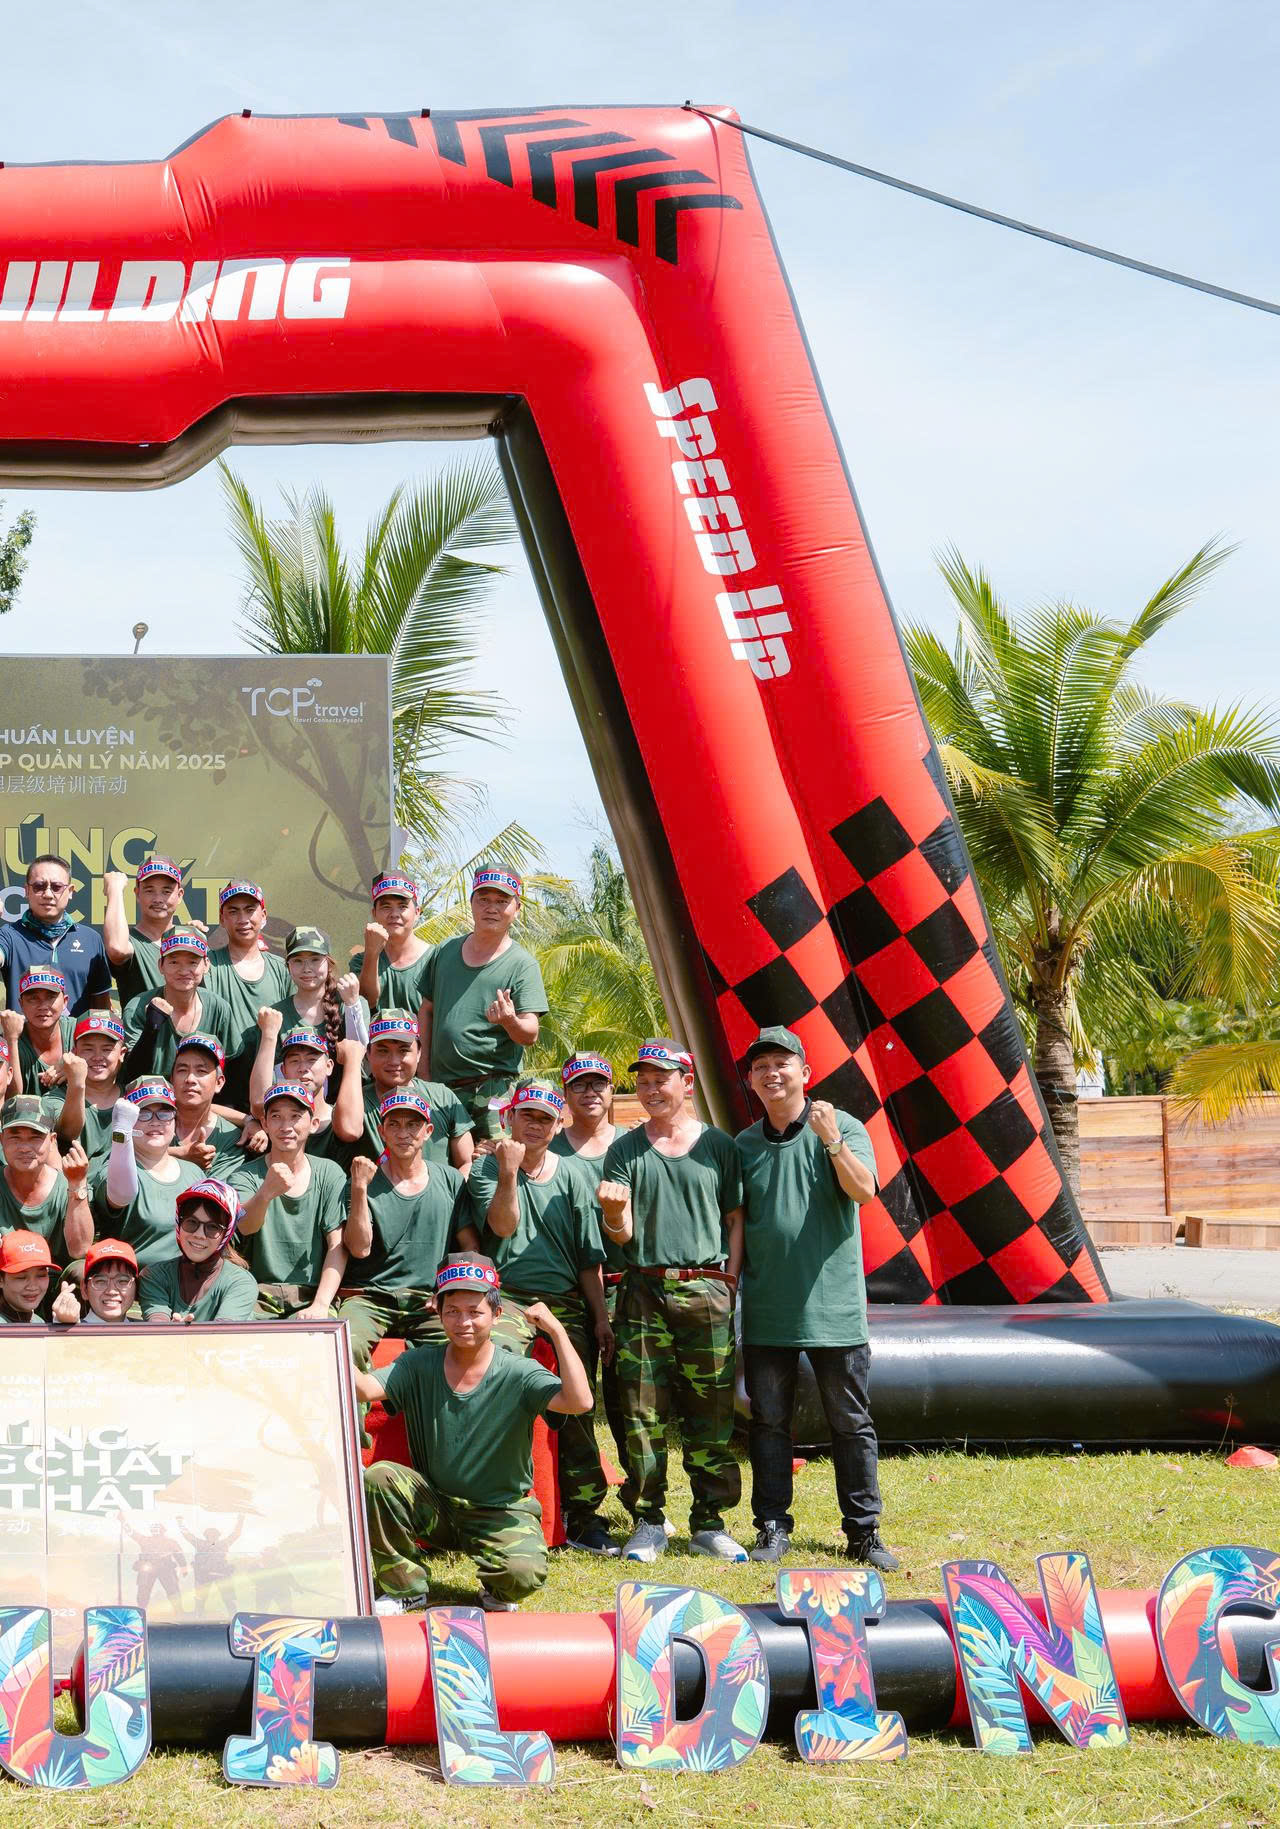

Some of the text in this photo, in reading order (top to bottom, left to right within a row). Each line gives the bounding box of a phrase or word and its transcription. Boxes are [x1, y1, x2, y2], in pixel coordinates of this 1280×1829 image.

[314, 701, 364, 717] travel
[64, 725, 135, 749] LUYỆN
[19, 749, 83, 772] QUẢN
[89, 750, 114, 770] LÝ
[120, 751, 170, 770] NĂM
[176, 754, 227, 770] 2025
[143, 864, 179, 878] TRIBECO
[378, 880, 414, 892] TRIBECO
[479, 874, 517, 888] TRIBECO
[168, 936, 206, 950] TRIBECO
[371, 1021, 411, 1031] TRIBECO
[570, 1060, 611, 1073] TRIBECO
[127, 1086, 168, 1102] TRIBECO
[386, 1096, 426, 1110] TRIBECO
[438, 1267, 484, 1284] TRIBECO
[24, 1441, 194, 1477] CHẤT
